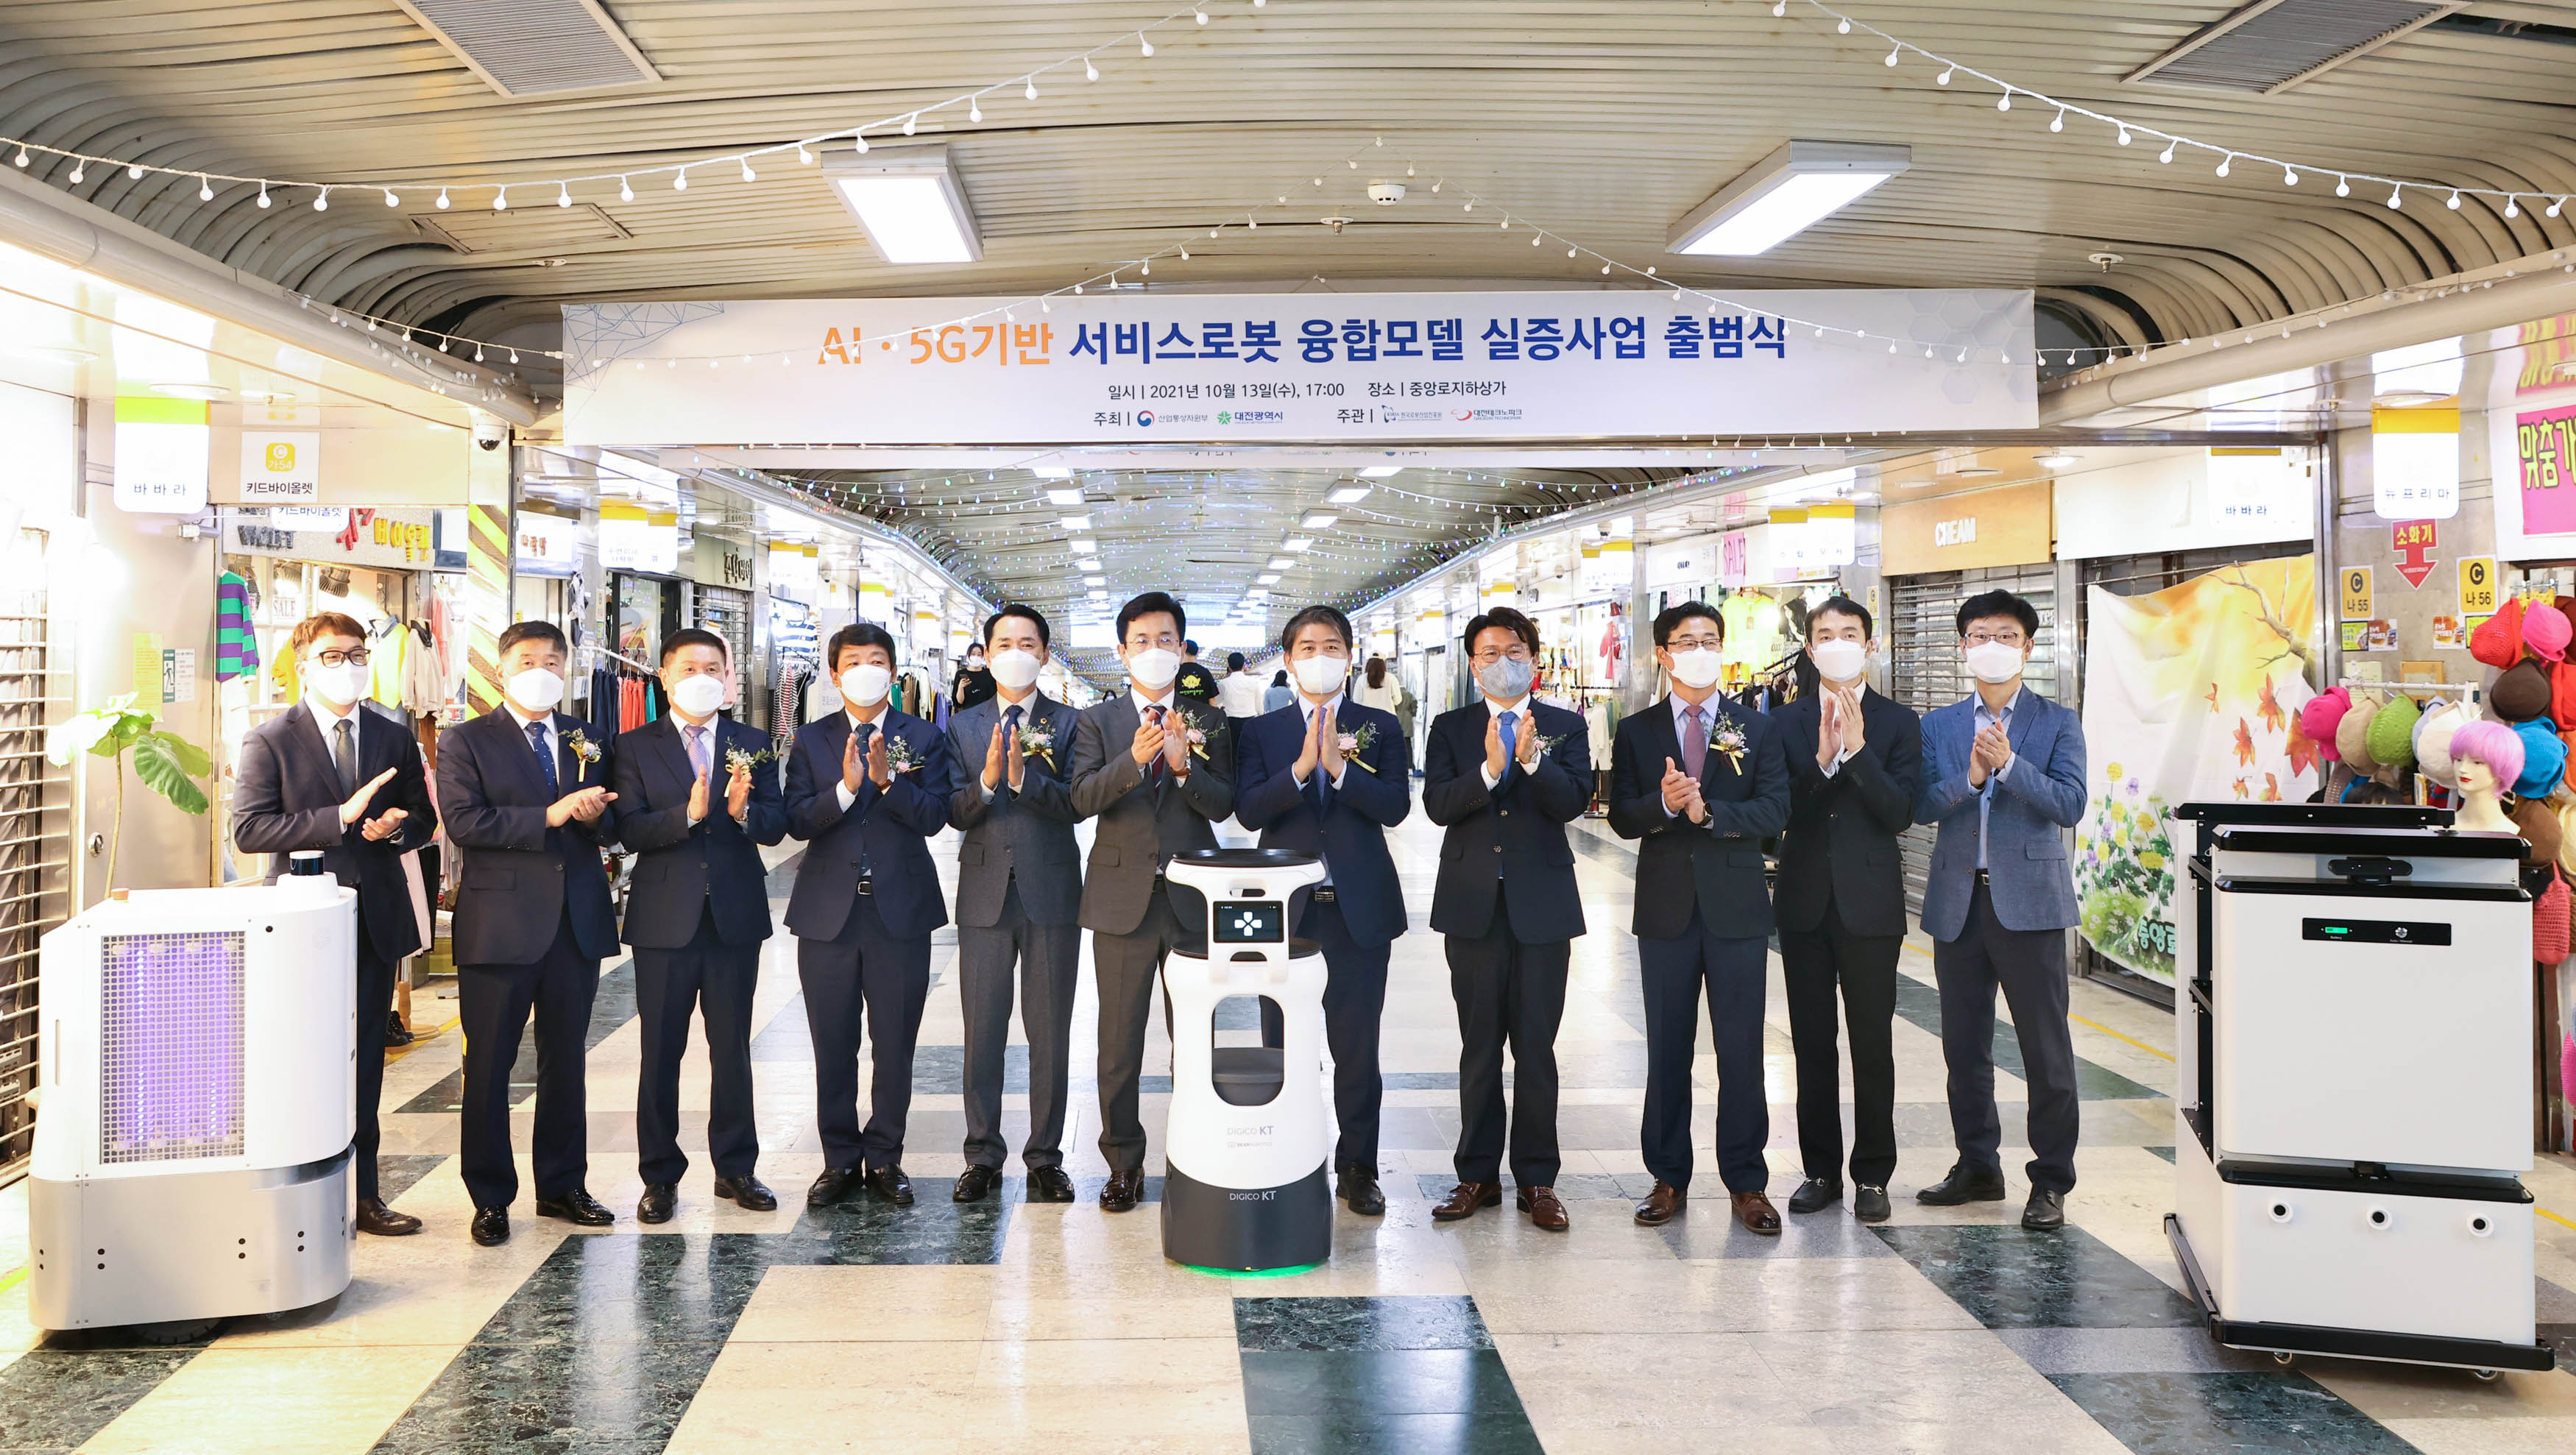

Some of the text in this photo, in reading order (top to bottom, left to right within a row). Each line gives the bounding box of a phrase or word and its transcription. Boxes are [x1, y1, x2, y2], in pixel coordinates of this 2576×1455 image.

[818, 327, 861, 365] AI
[910, 323, 1055, 366] 5G기반
[1069, 319, 1281, 365] 서비스로봇
[1298, 318, 1464, 363] 융합모델
[1481, 317, 1646, 361] 실증사업
[1664, 315, 1785, 359] 출범식
[1108, 385, 1135, 400] 일시
[1150, 385, 1198, 398] 2021년
[1206, 384, 1235, 398] 10월
[1242, 383, 1301, 399] 13일(수),
[1306, 383, 1345, 397] 17:00
[1367, 382, 1395, 397] 장소
[1409, 381, 1507, 397] 중앙로지하상가
[1094, 412, 1121, 427] 주최
[1234, 411, 1283, 420] 대전광역시
[1337, 408, 1365, 424] 주관
[247, 482, 313, 495] 키드바이올렛
[1935, 517, 1977, 547] CREAM
[2396, 523, 2433, 545] 소화기
[2347, 599, 2368, 612] 나 55
[2466, 591, 2491, 606] 나 56
[273, 600, 295, 617] SALE
[1227, 1125, 1274, 1136] DIGICO KT
[1230, 1190, 1277, 1201] DIGICO KT
